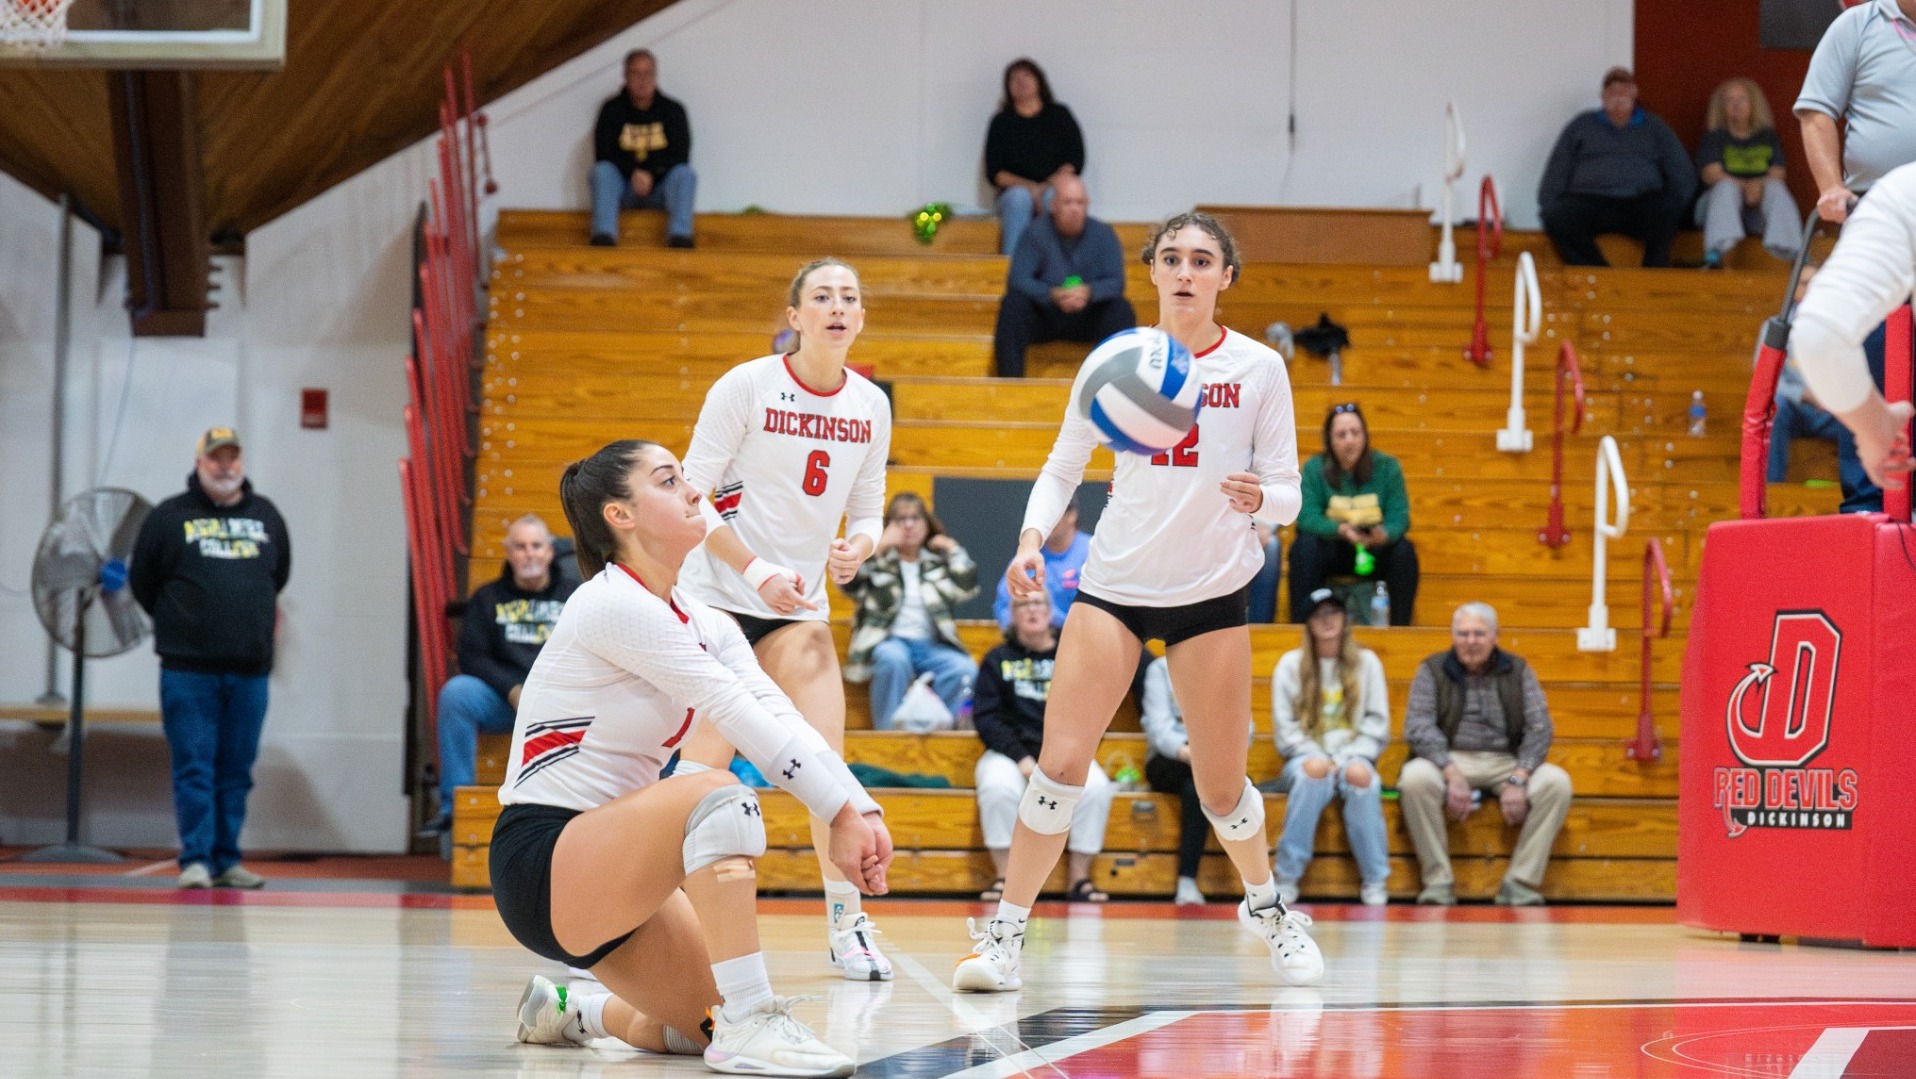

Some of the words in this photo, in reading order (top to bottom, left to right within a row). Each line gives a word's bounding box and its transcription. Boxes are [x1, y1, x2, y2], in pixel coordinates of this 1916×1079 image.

[763, 407, 872, 444] DICKINSON
[802, 449, 831, 497] 6
[1713, 767, 1762, 809] RED
[1764, 768, 1859, 812] DEVILS
[1746, 811, 1846, 828] DICKINSON
